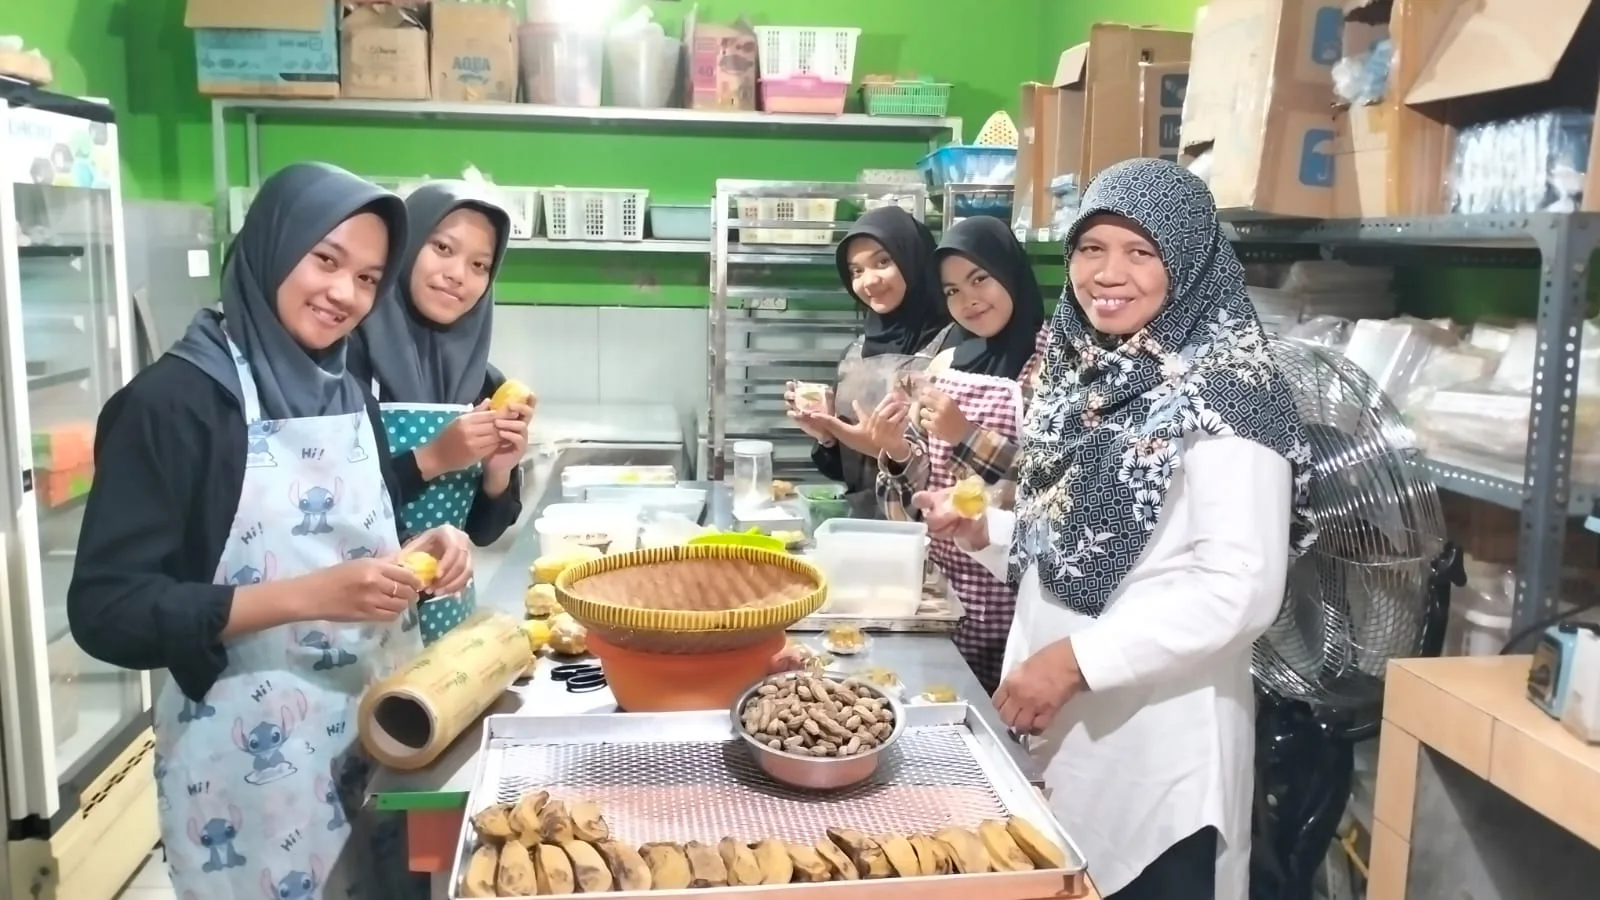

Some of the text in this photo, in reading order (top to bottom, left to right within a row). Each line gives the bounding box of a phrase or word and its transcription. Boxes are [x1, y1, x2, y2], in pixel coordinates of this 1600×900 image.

[452, 56, 491, 71] AQUA
[301, 447, 325, 461] Hi!
[363, 509, 377, 530] Hi!
[241, 521, 264, 545] Hi!
[251, 680, 273, 703] Hi!
[326, 720, 346, 737] Hi!
[187, 780, 211, 796] Hi!
[280, 828, 303, 852] Hi!
